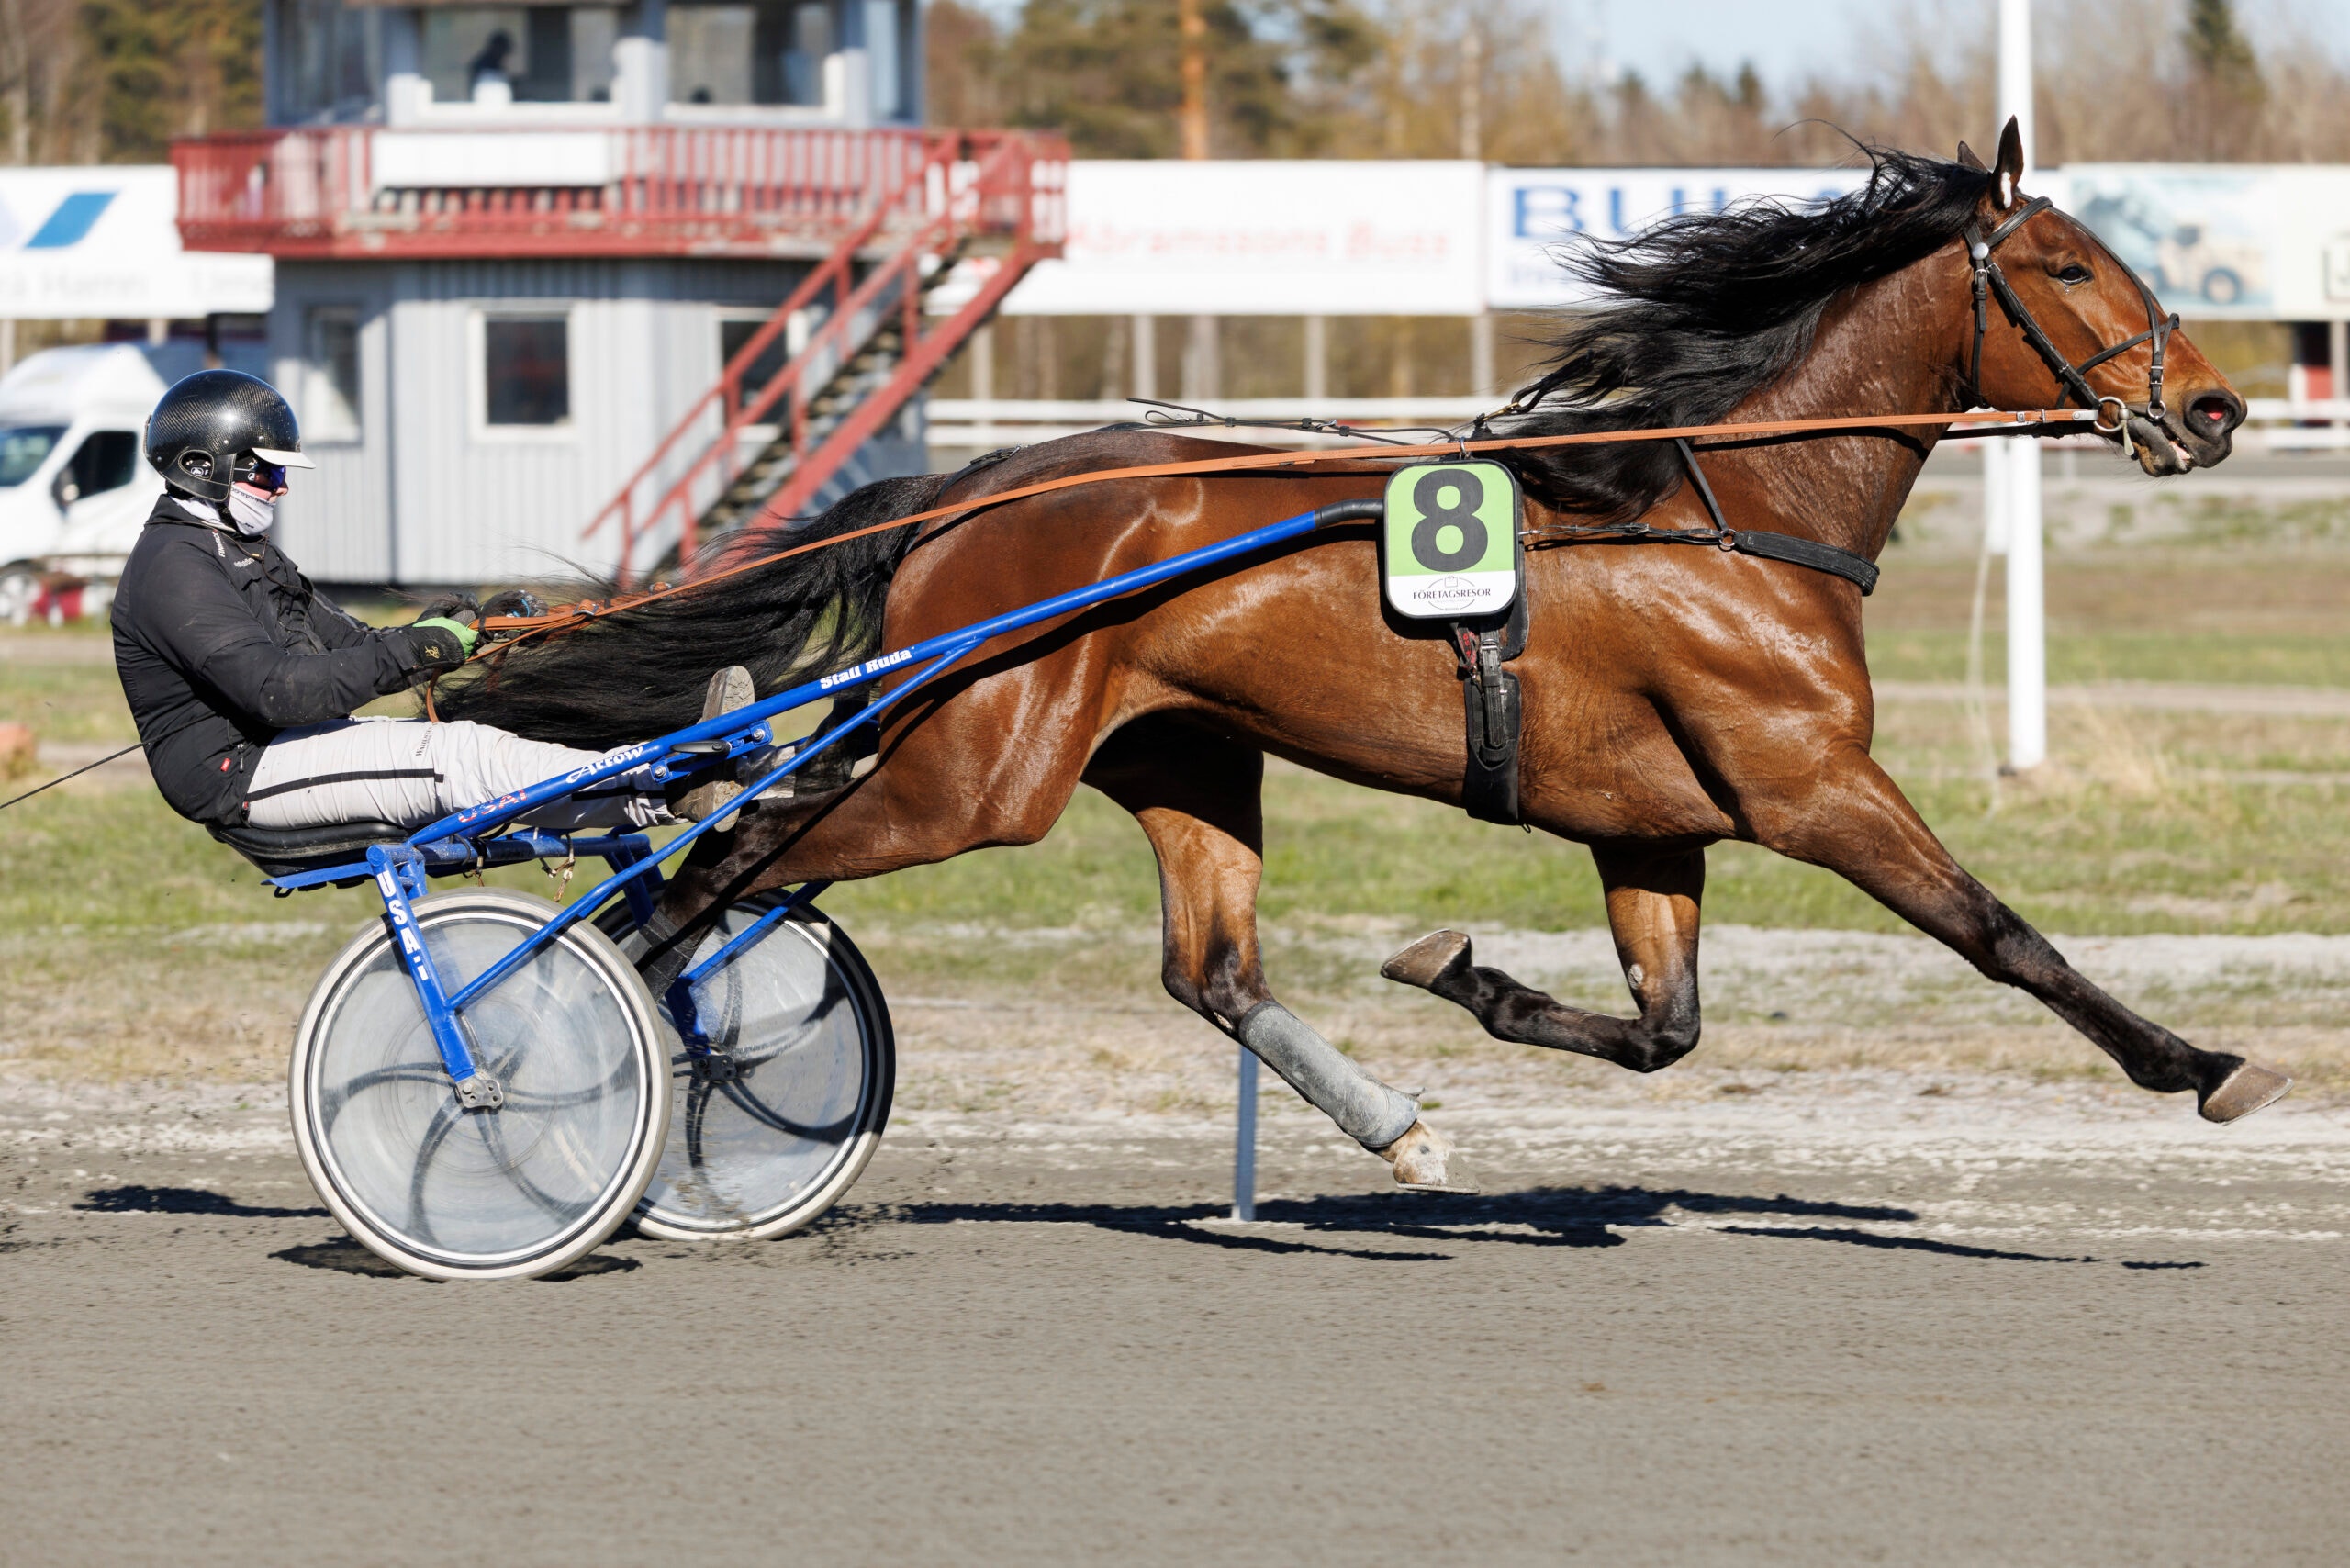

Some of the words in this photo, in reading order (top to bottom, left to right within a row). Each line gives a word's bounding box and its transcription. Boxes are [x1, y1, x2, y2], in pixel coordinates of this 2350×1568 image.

[1411, 468, 1489, 572] 8
[1413, 588, 1492, 600] FÖRETAGSRESOR
[820, 665, 862, 689] Stall
[565, 745, 643, 784] Arrow
